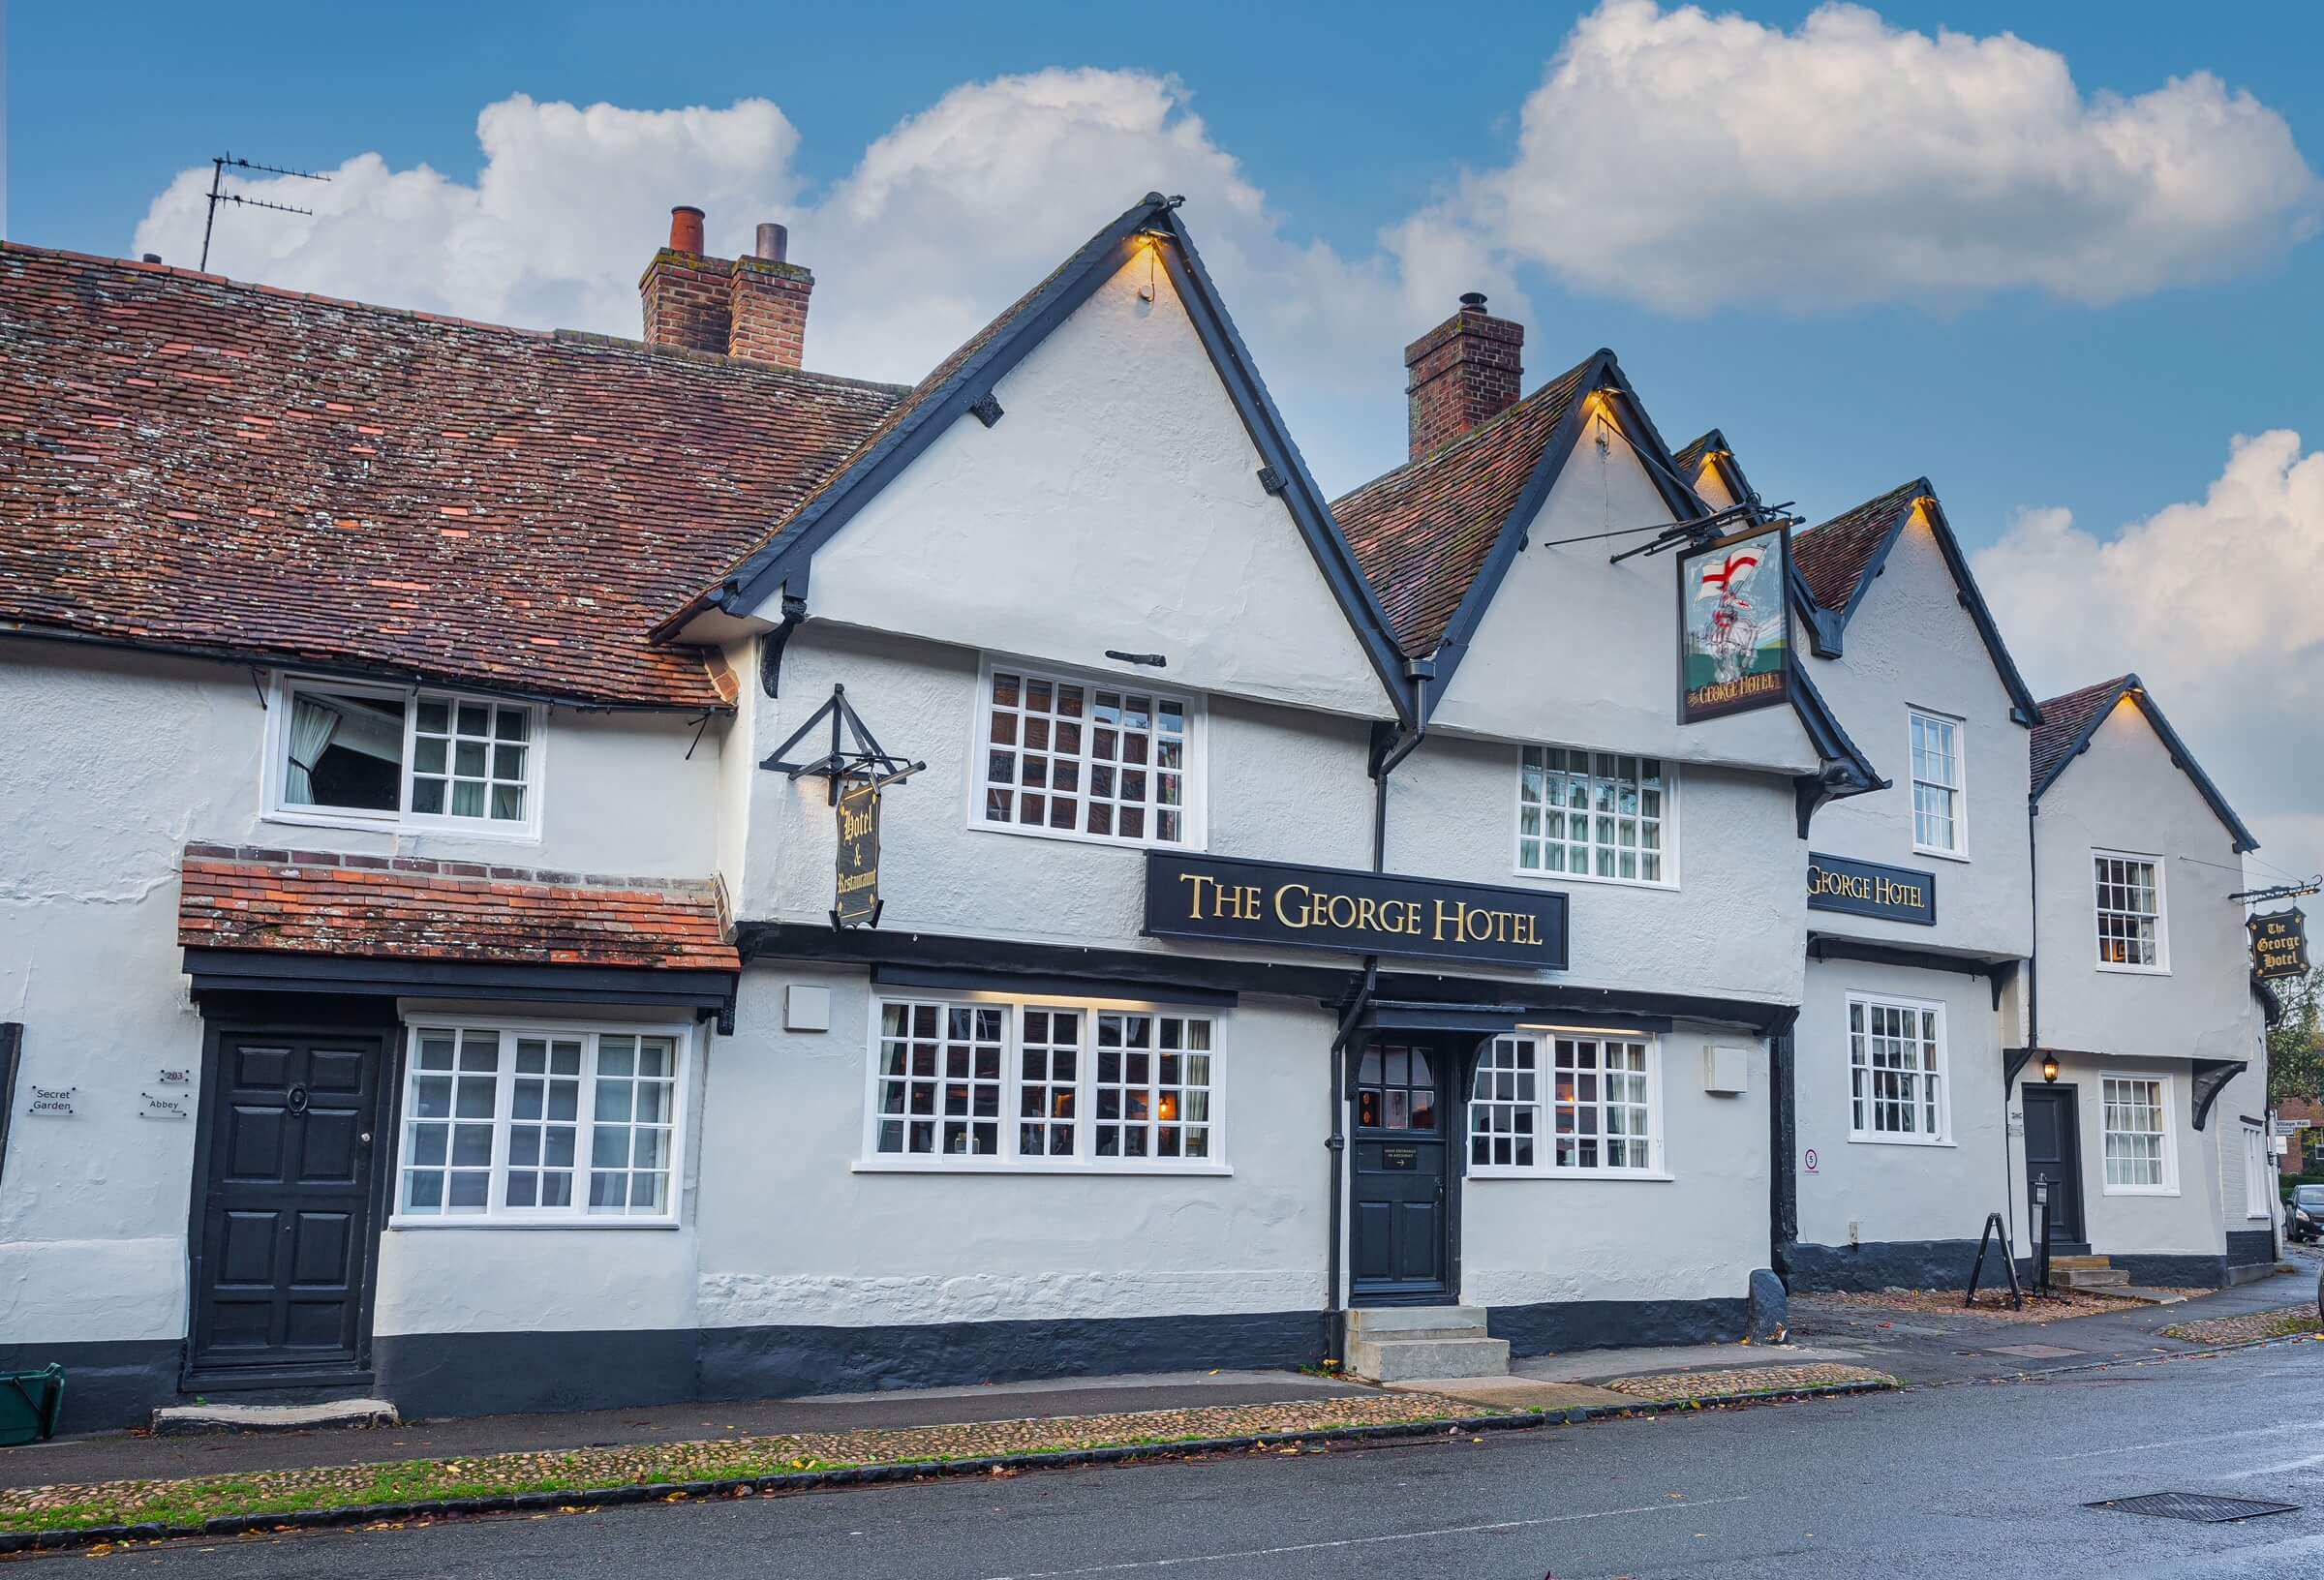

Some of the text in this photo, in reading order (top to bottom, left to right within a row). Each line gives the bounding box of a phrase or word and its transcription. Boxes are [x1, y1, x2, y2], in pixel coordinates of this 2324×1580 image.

[1699, 681, 1738, 704] GEORGE
[1739, 672, 1775, 695] HOTEL
[844, 804, 872, 847] Hotel
[853, 843, 862, 867] &
[1807, 865, 1925, 908] GEORGE HOTEL
[1179, 873, 1544, 946] THE GEORGE HOTEL
[2266, 923, 2285, 935] The
[2256, 936, 2300, 953] George
[2263, 951, 2299, 970] Hotel
[37, 1089, 71, 1099] Secret
[33, 1101, 71, 1110] Garden
[149, 1100, 179, 1109] Abbey
